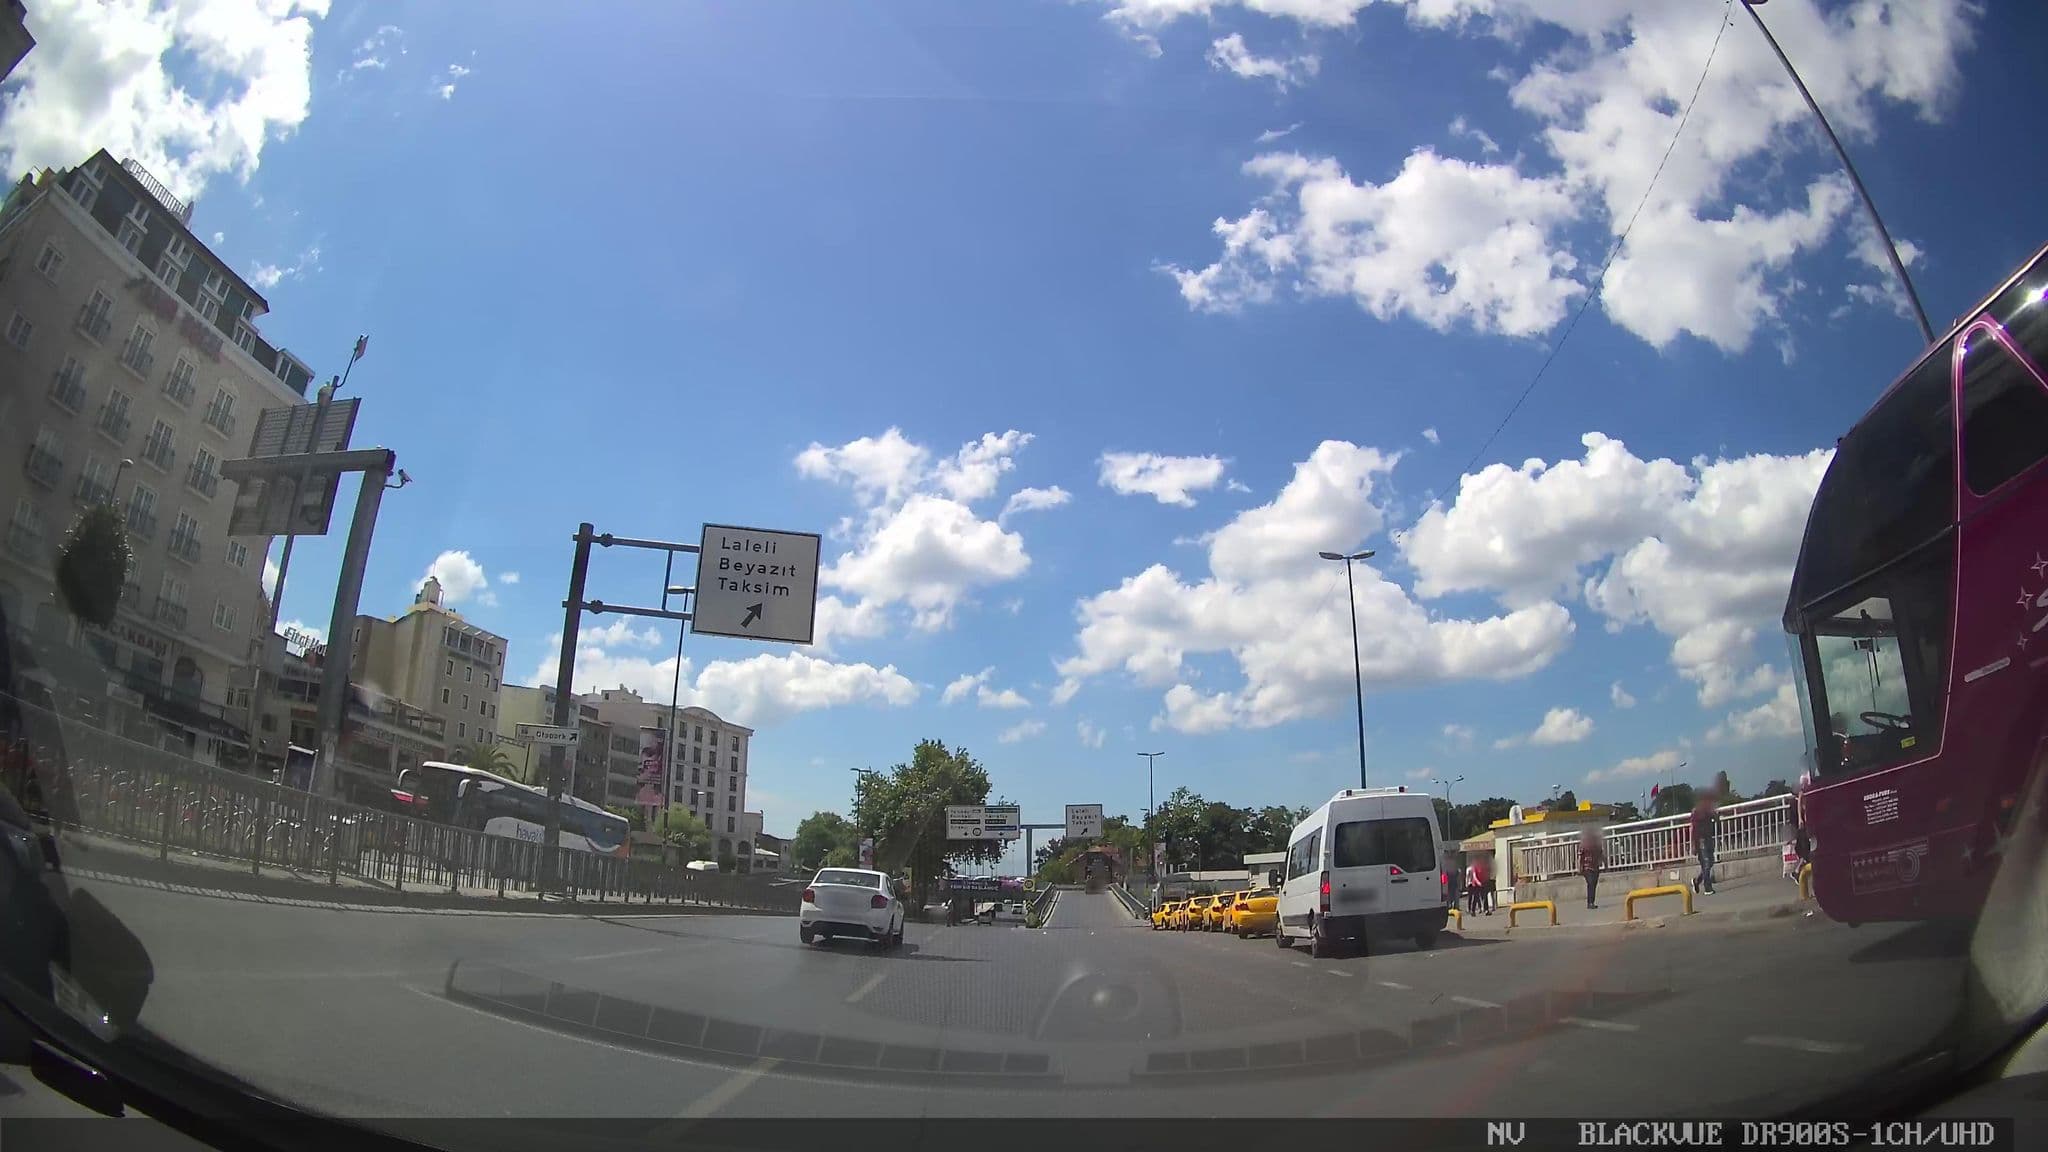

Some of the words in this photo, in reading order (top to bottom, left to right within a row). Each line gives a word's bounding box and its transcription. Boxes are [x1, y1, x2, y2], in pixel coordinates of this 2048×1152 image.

[721, 536, 777, 554] Laleli
[719, 557, 796, 577] Beyazıt
[717, 576, 790, 597] Taksim
